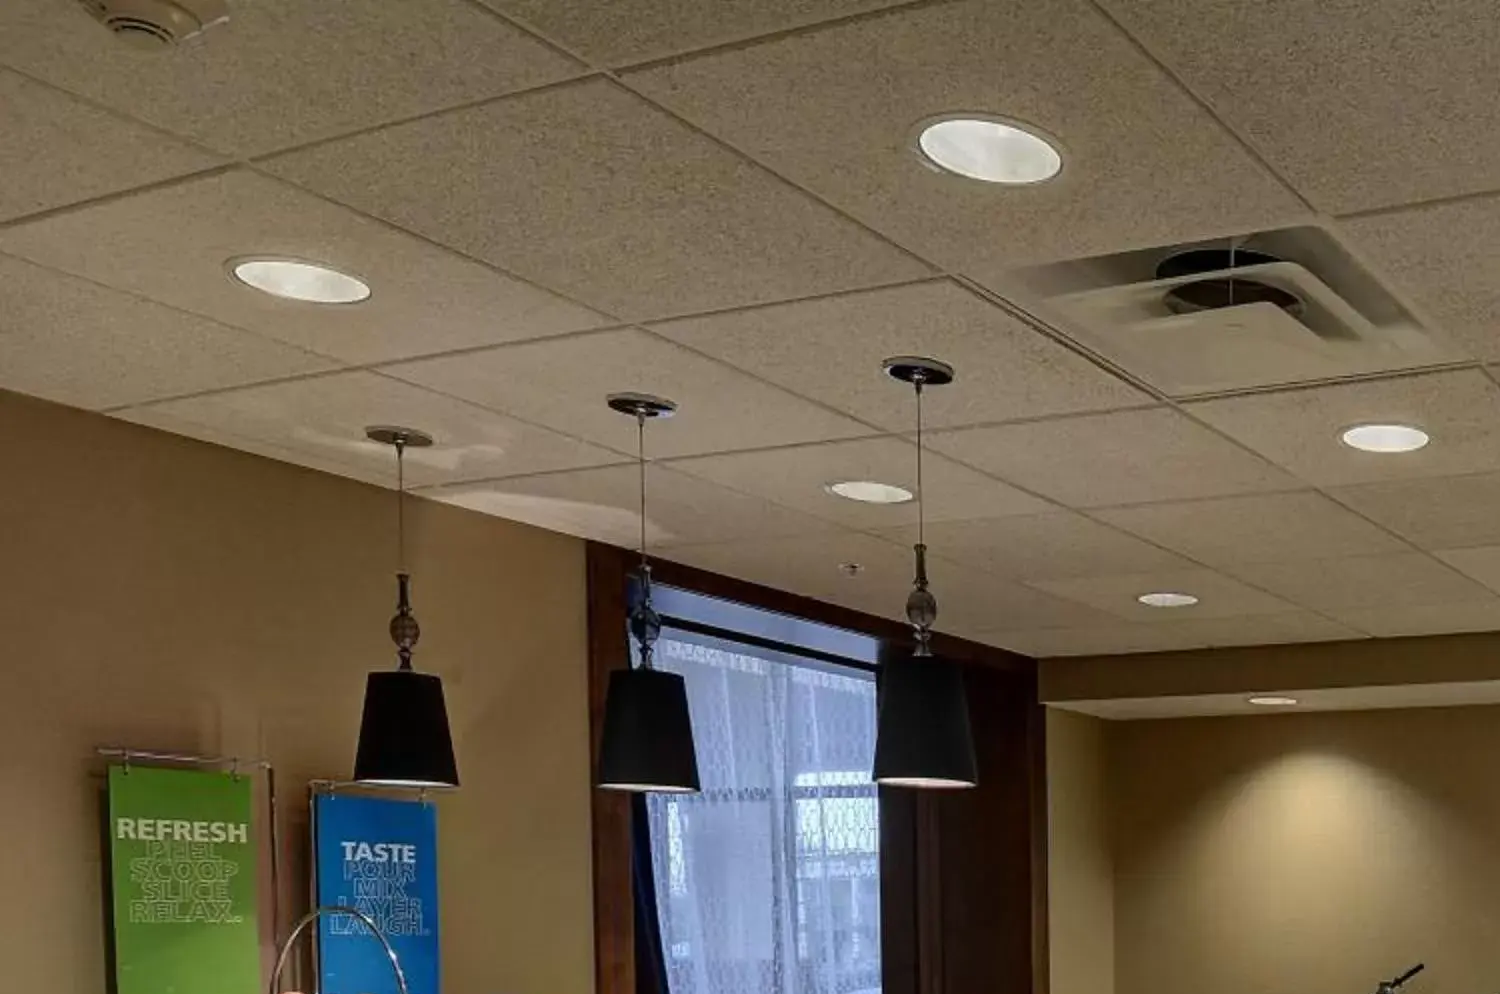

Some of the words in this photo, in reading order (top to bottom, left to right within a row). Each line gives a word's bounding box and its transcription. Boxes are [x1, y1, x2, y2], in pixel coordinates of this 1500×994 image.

[116, 818, 248, 843] REFRESH
[146, 840, 221, 859] PEEL
[340, 841, 417, 863] TASTE
[130, 857, 239, 882] SCOOP
[343, 860, 417, 882] POUR
[140, 879, 232, 901] SLICE
[353, 877, 407, 898] MIX
[129, 899, 244, 923] RELAX.
